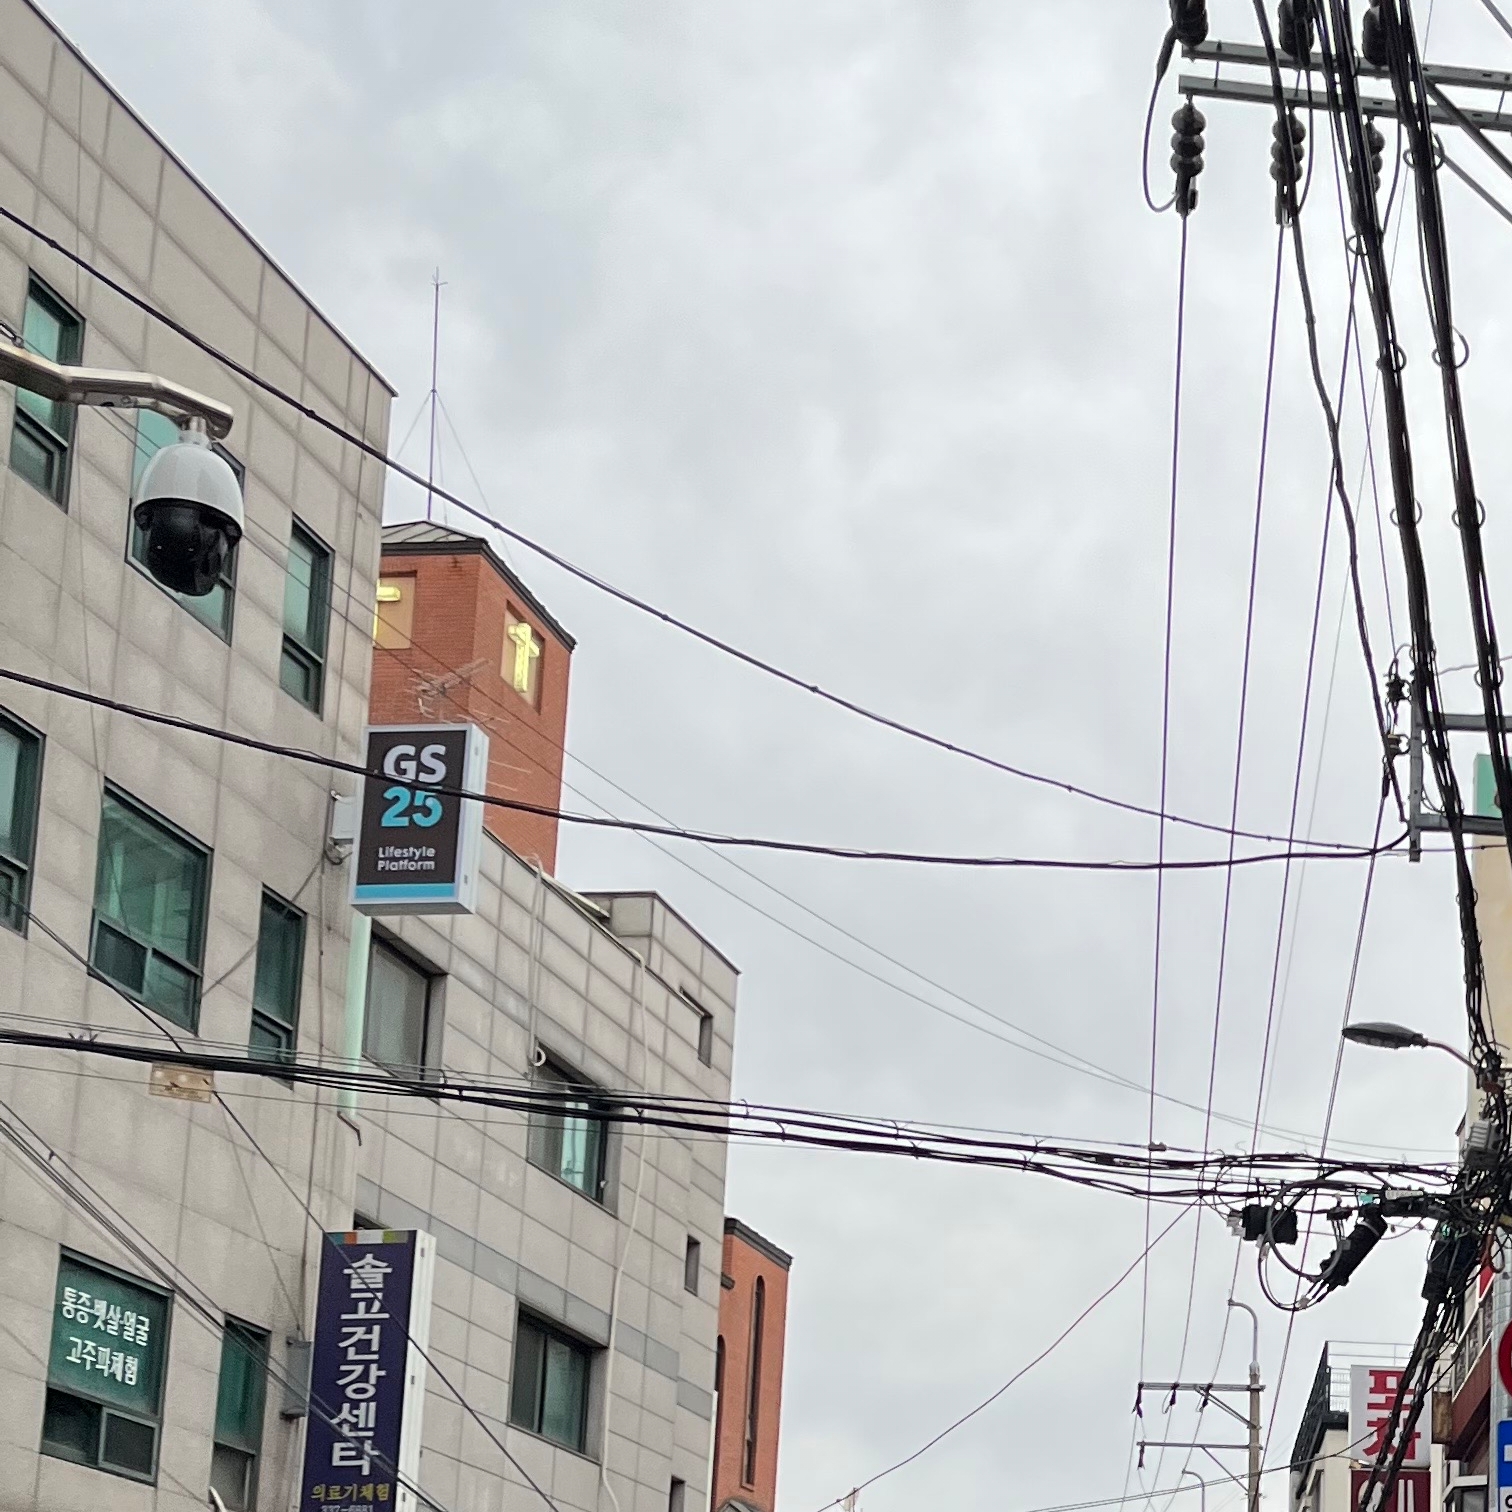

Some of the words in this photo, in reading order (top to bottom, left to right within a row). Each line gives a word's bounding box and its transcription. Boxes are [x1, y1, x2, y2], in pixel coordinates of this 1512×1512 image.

[383, 744, 446, 783] GS
[381, 785, 442, 827] 25
[377, 859, 435, 871] Platform
[378, 846, 436, 860] Lifestyle
[65, 1336, 139, 1385] 고주파체험
[332, 1253, 393, 1475] 솔고건강센타
